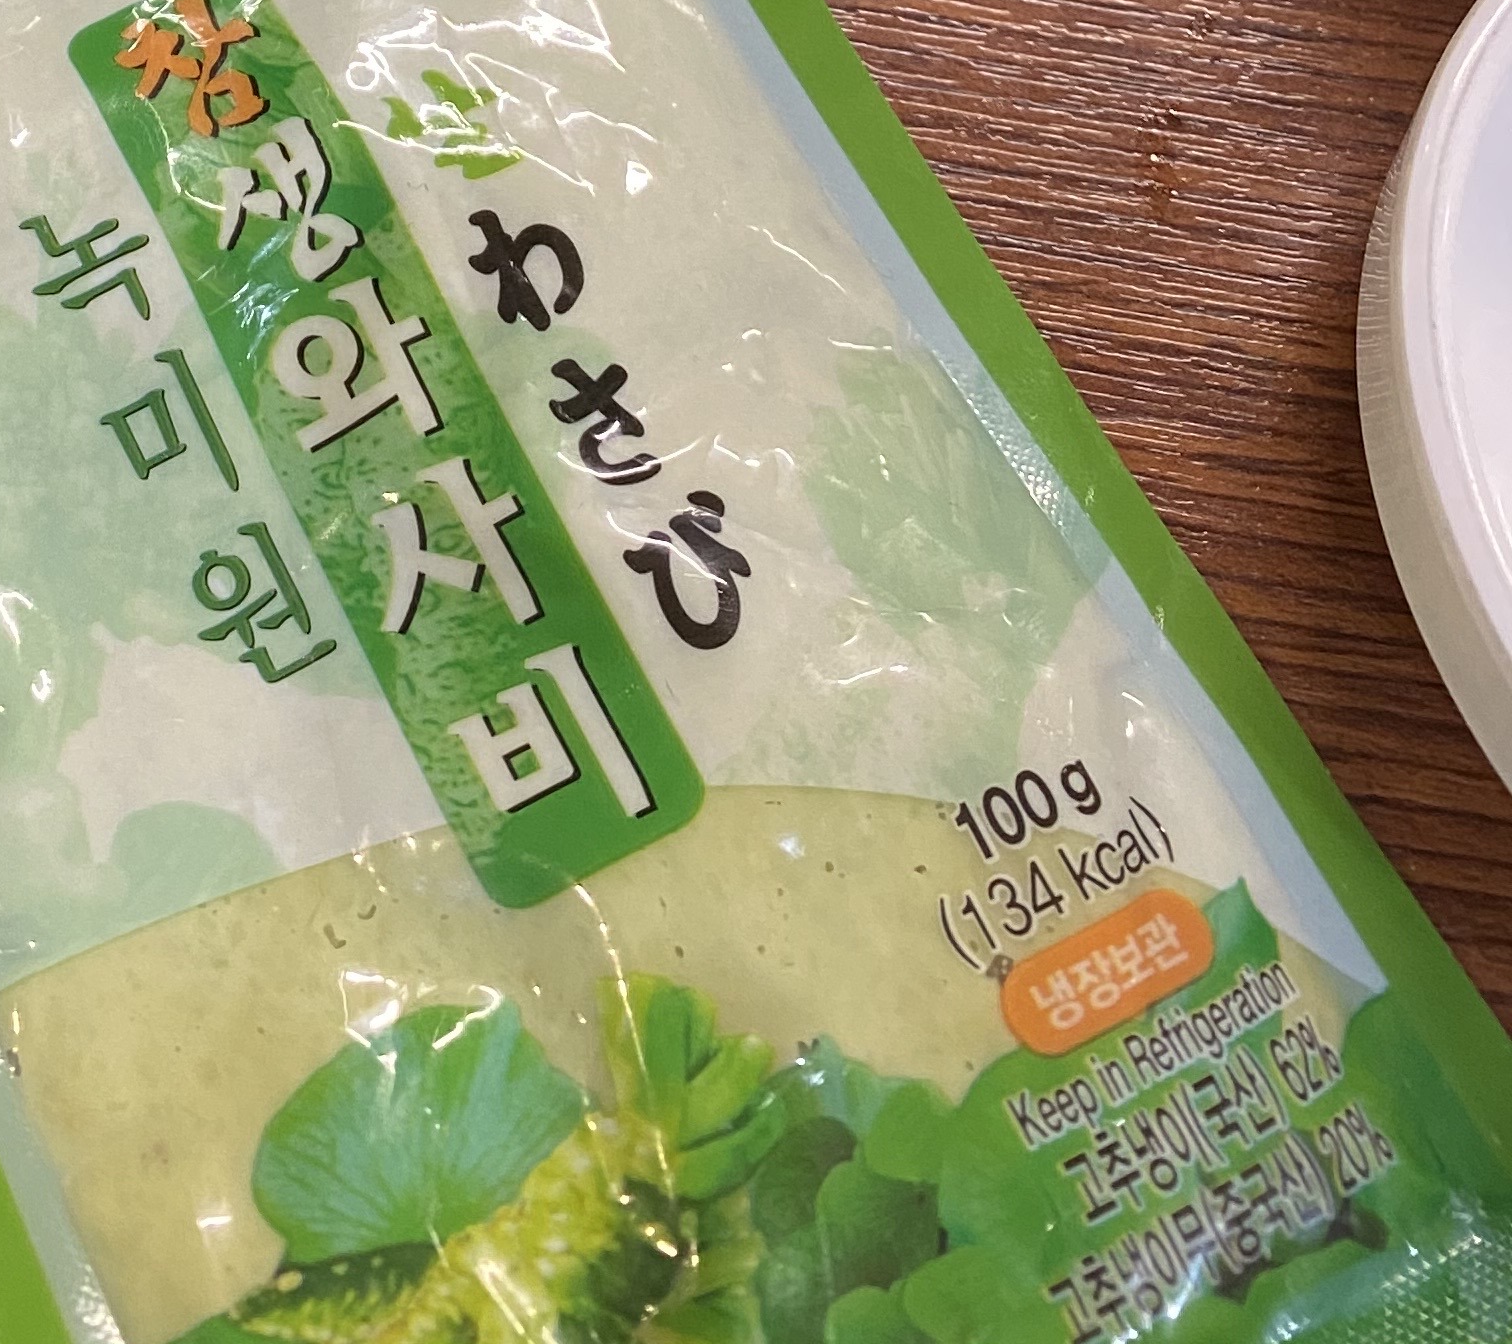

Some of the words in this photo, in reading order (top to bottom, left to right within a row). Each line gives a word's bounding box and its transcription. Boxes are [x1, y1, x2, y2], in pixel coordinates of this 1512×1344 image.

[18, 213, 337, 684] 녹미원
[467, 207, 752, 650] わさび
[939, 860, 1064, 971] (134
[1057, 795, 1175, 901] kcal)
[1029, 914, 1188, 1030] 냉장보관
[1007, 1078, 1100, 1145] Keep
[1090, 1055, 1135, 1103] in
[1122, 964, 1296, 1085] Refrigeration
[1063, 1046, 1287, 1220] 고추냉이(국산)
[1269, 1015, 1342, 1101] 62%
[1318, 1103, 1395, 1189] 20%
